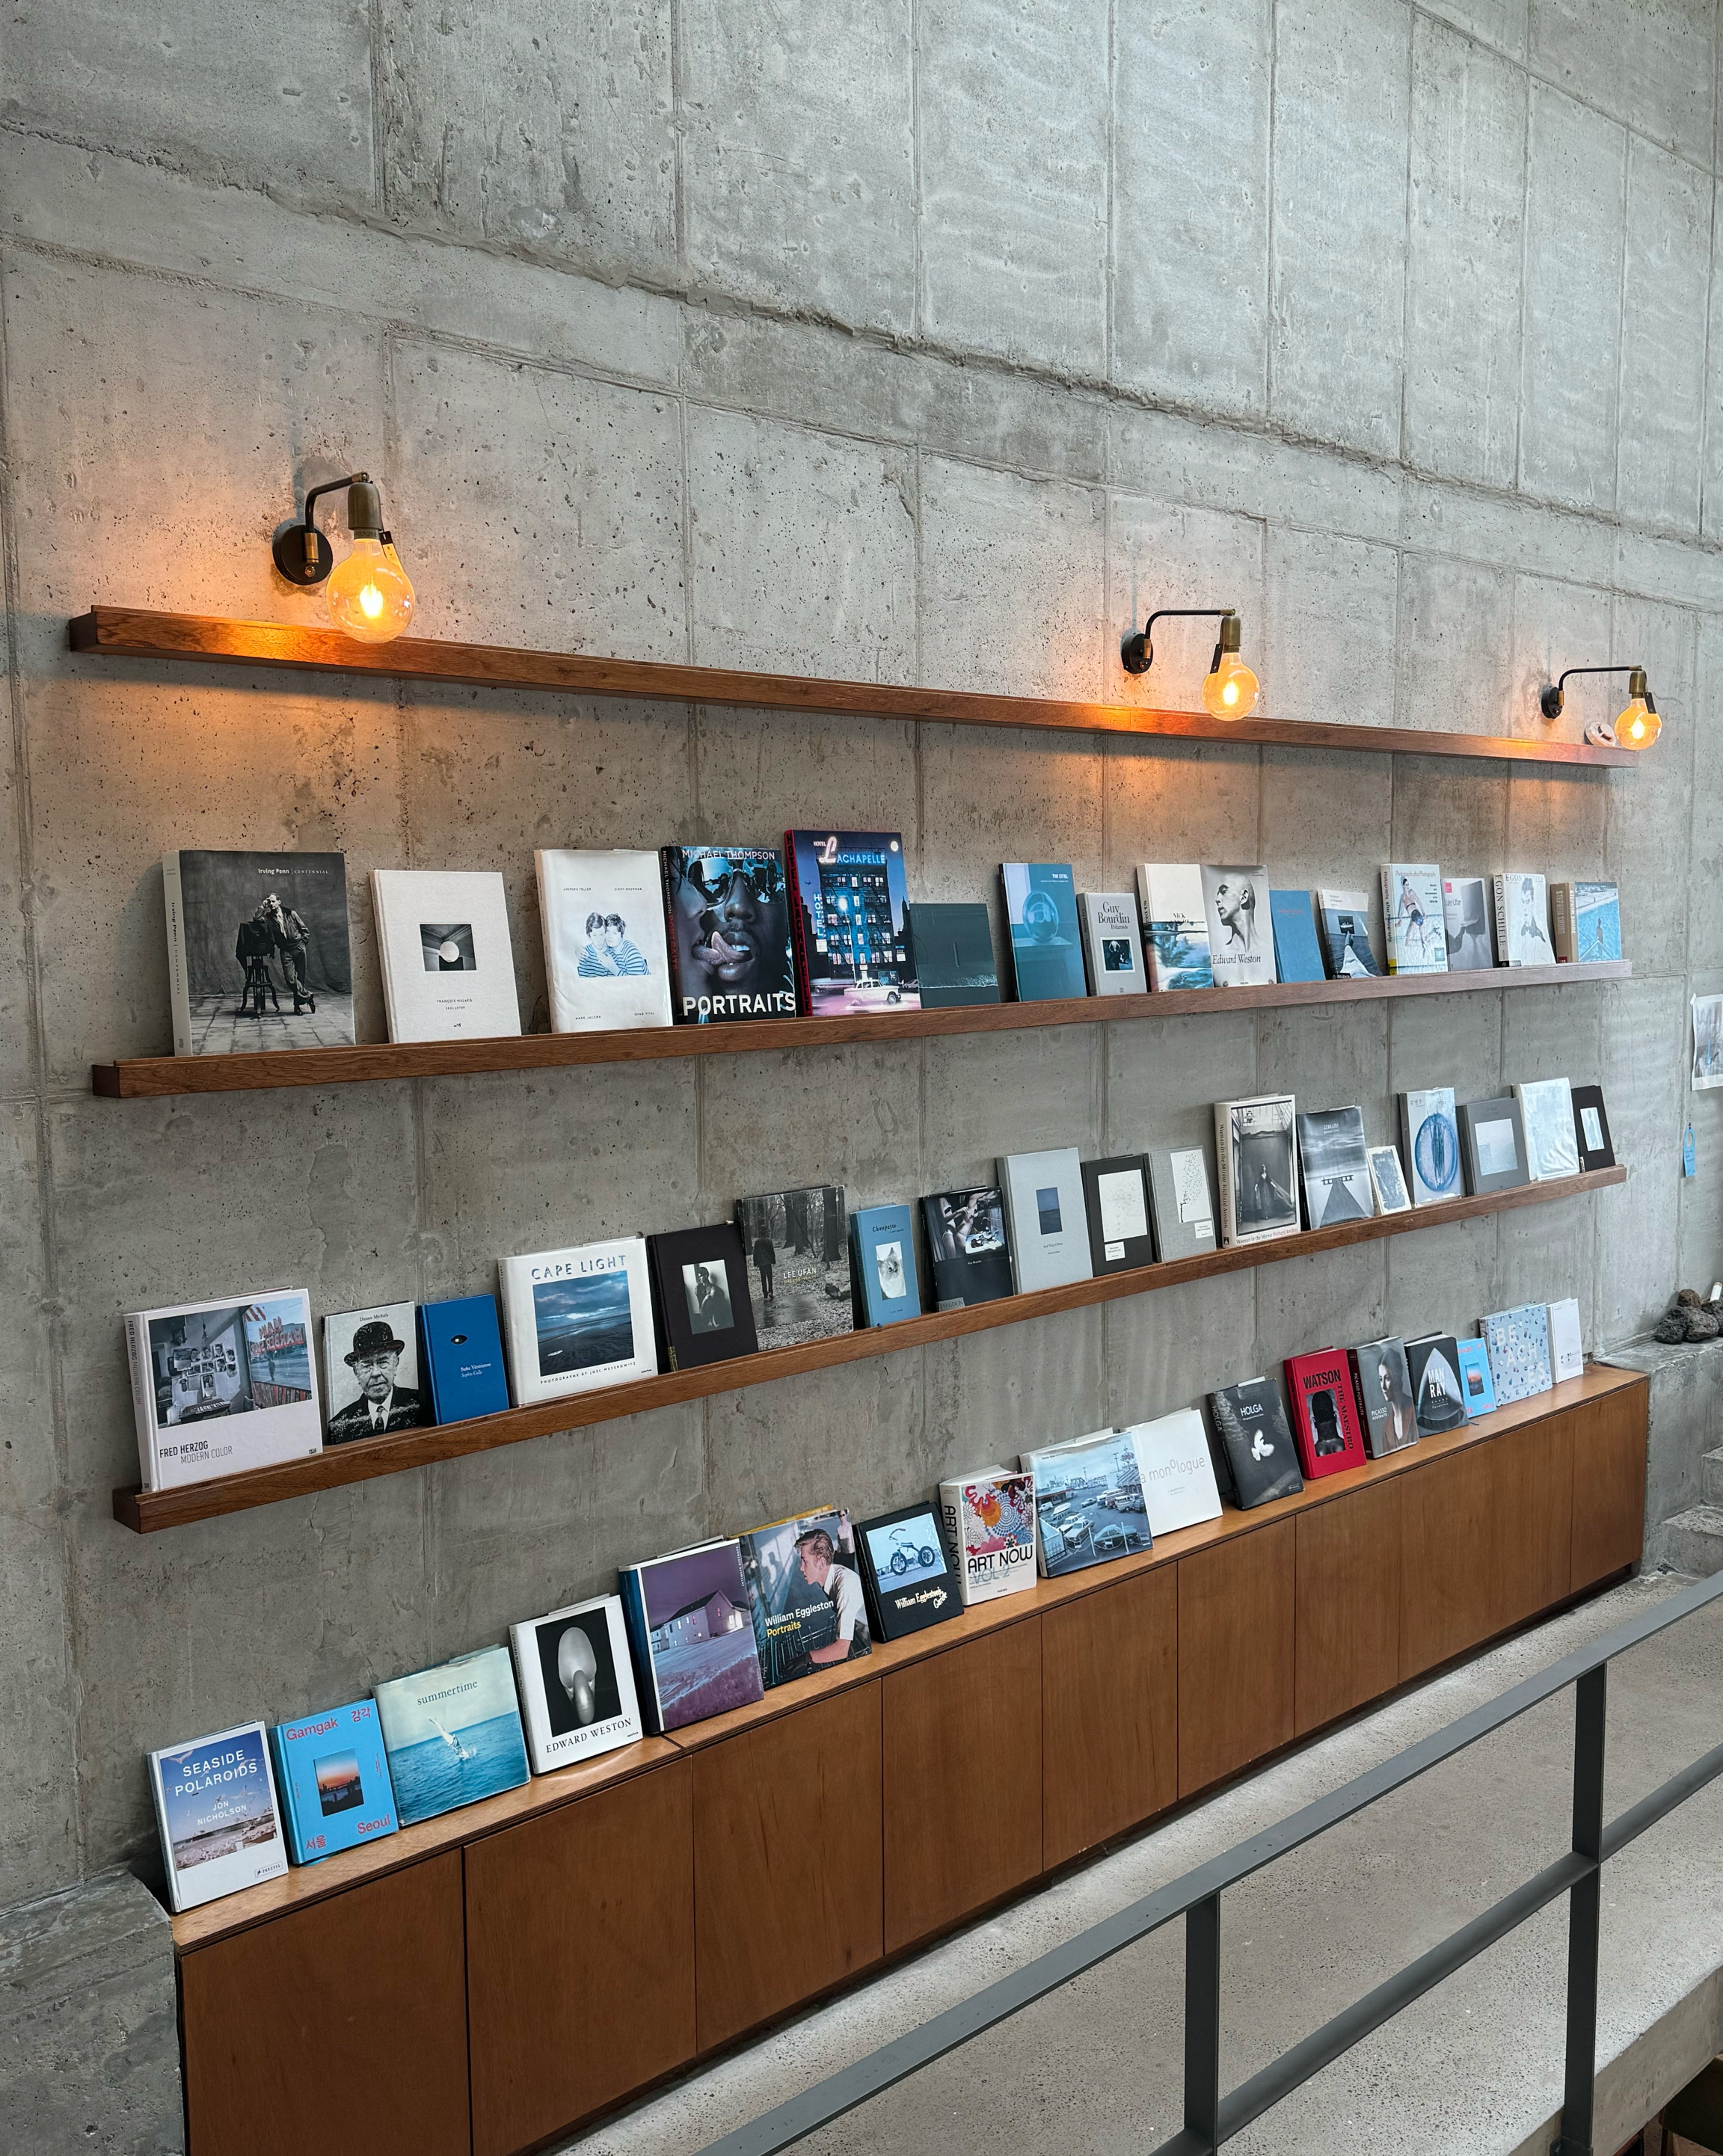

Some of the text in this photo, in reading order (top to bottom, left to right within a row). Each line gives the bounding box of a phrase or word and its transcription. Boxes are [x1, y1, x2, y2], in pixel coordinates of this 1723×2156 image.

[682, 850, 775, 859] MICHAEL THOMPSON
[1495, 875, 1503, 902] EGON
[814, 894, 824, 936] HOTEL
[1103, 901, 1120, 913] Guy
[1098, 912, 1130, 924] Bourdin
[1497, 906, 1507, 946] SCHIELE
[669, 914, 678, 970] PORTRAITS
[1213, 954, 1261, 964] Edward Weston
[682, 992, 796, 1016] PORTRAITS
[872, 1223, 897, 1232] Choupette
[531, 1255, 626, 1280] CAPE LIGHT
[783, 1271, 796, 1279] LEE
[798, 1267, 817, 1277] UFAN
[939, 1300, 963, 1309] PHAIDON
[1496, 1324, 1516, 1346] BE
[1507, 1343, 1537, 1368] ACH
[604, 1362, 636, 1372] MEYEROWITZ
[1428, 1367, 1445, 1384] MAN
[1527, 1361, 1545, 1384] ES
[1303, 1369, 1342, 1389] WATSON
[1429, 1381, 1446, 1398] RAY
[1211, 1406, 1223, 1432] HOLGA
[1240, 1404, 1264, 1416] HOLGA
[1372, 1407, 1387, 1416] PICASSO
[1339, 1404, 1354, 1449] MAESTRO
[159, 1440, 209, 1458] FRED HERZOG
[181, 1446, 233, 1464] MODERN COLOR
[945, 1505, 957, 1537] ART
[968, 1545, 1033, 1573] ART NOW
[971, 1568, 1000, 1585] VOL
[1002, 1564, 1010, 1578] 2
[894, 1597, 916, 1609] William
[933, 1591, 948, 1609] Guide
[765, 1600, 834, 1627] William Eggleston
[767, 1621, 802, 1638] Portraits
[417, 1681, 478, 1705] summertime
[351, 1707, 371, 1722] 감각
[286, 1717, 339, 1741] Gamgak
[547, 1718, 632, 1753] EDWARD WESTON
[182, 1749, 245, 1777] SEASIDE
[174, 1763, 258, 1797] POLAROIDS
[197, 1805, 247, 1825] NICHOLSON
[212, 1800, 229, 1811] JON
[357, 1813, 390, 1834] Seoul
[306, 1834, 326, 1850] 서울
[262, 1864, 281, 1873] PRESTEL
